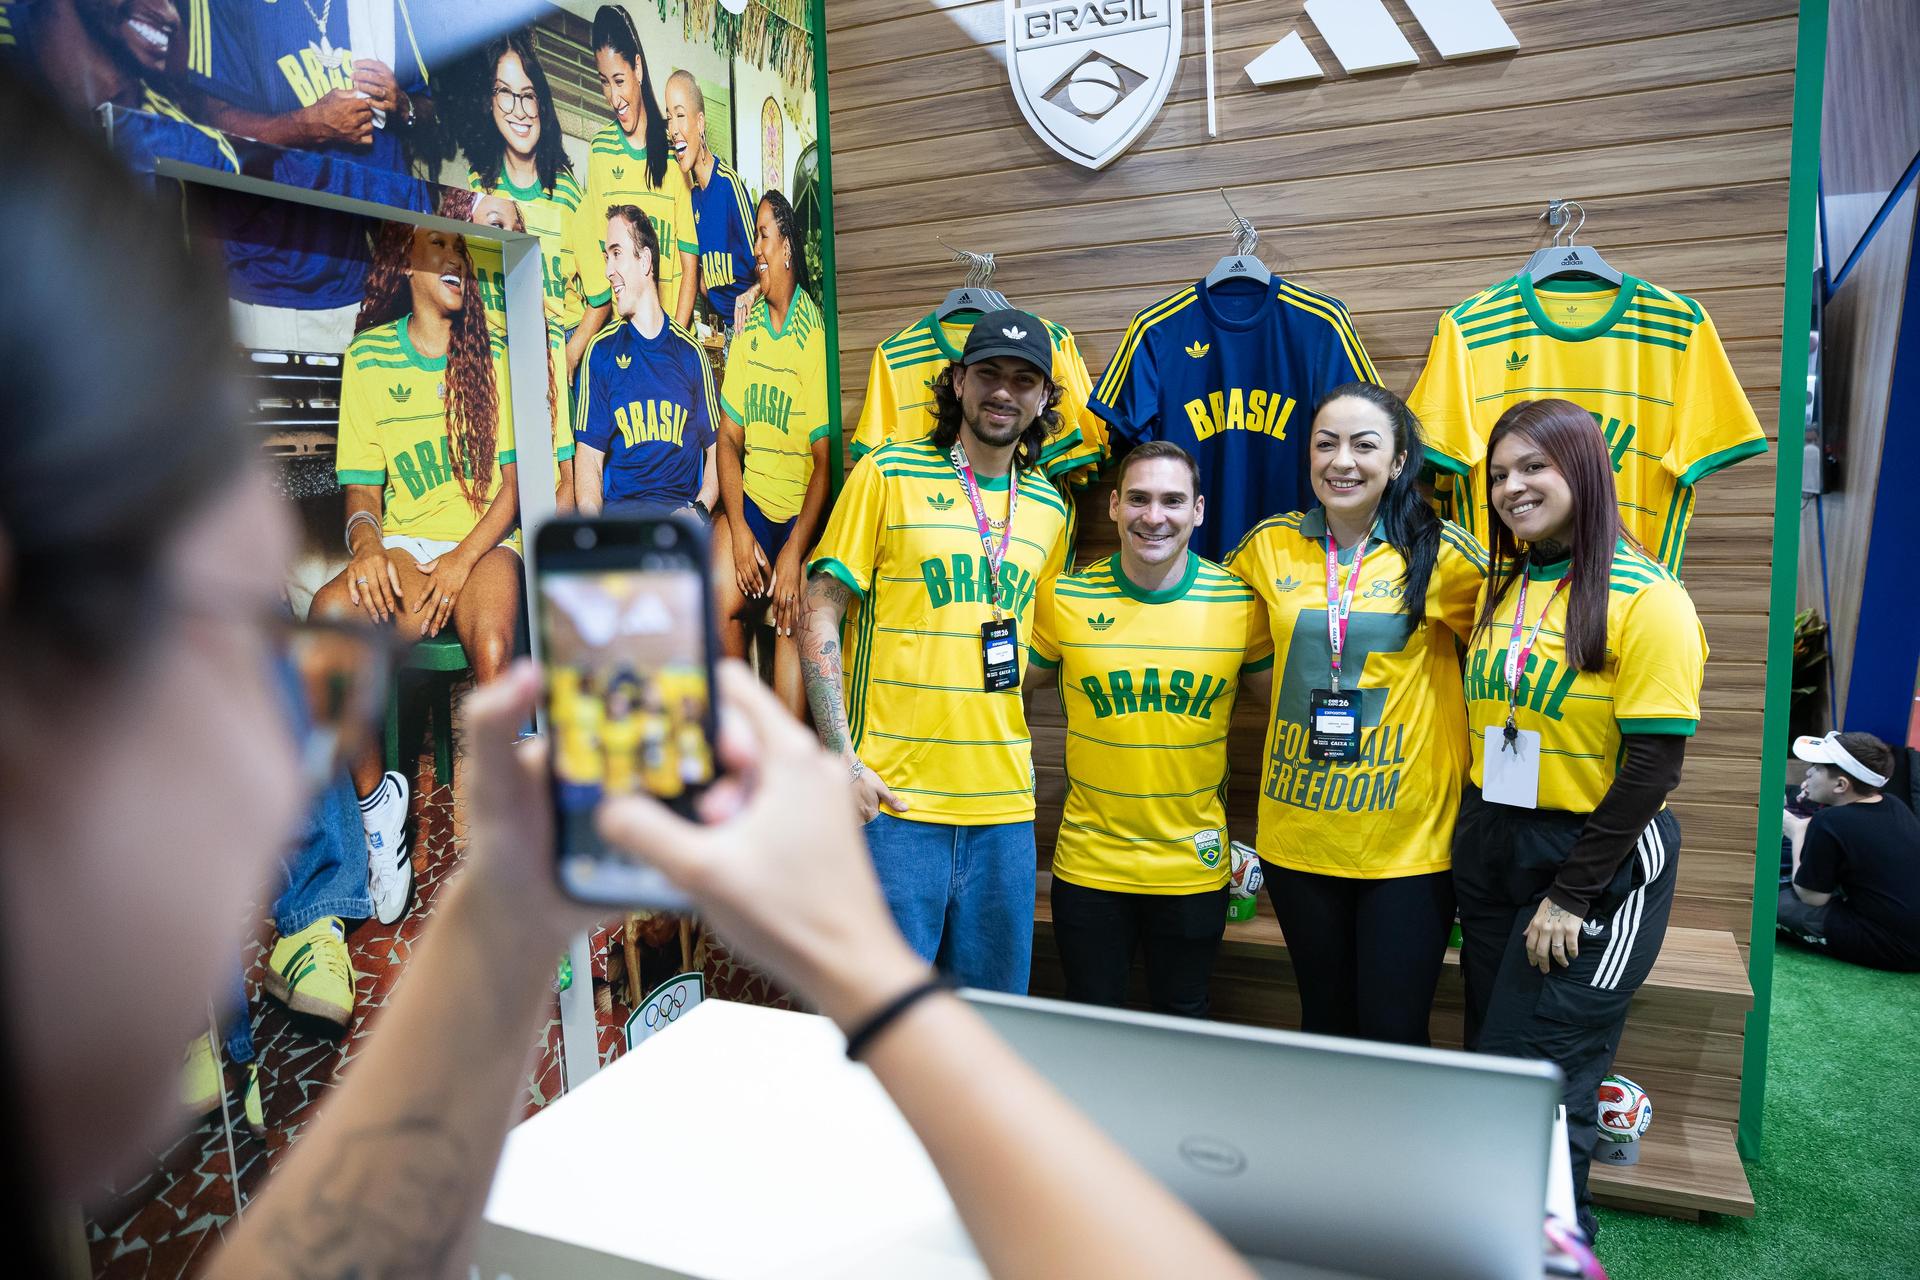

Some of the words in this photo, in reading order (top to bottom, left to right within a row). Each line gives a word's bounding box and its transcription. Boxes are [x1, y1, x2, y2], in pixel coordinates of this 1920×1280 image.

[1024, 0, 1158, 39] BRASIL
[614, 400, 688, 449] BRASIL
[1184, 388, 1296, 441] BRASIL
[920, 553, 1036, 624] BRASIL
[1080, 668, 1227, 720] BRASIL
[1265, 758, 1400, 813] FREEDOM
